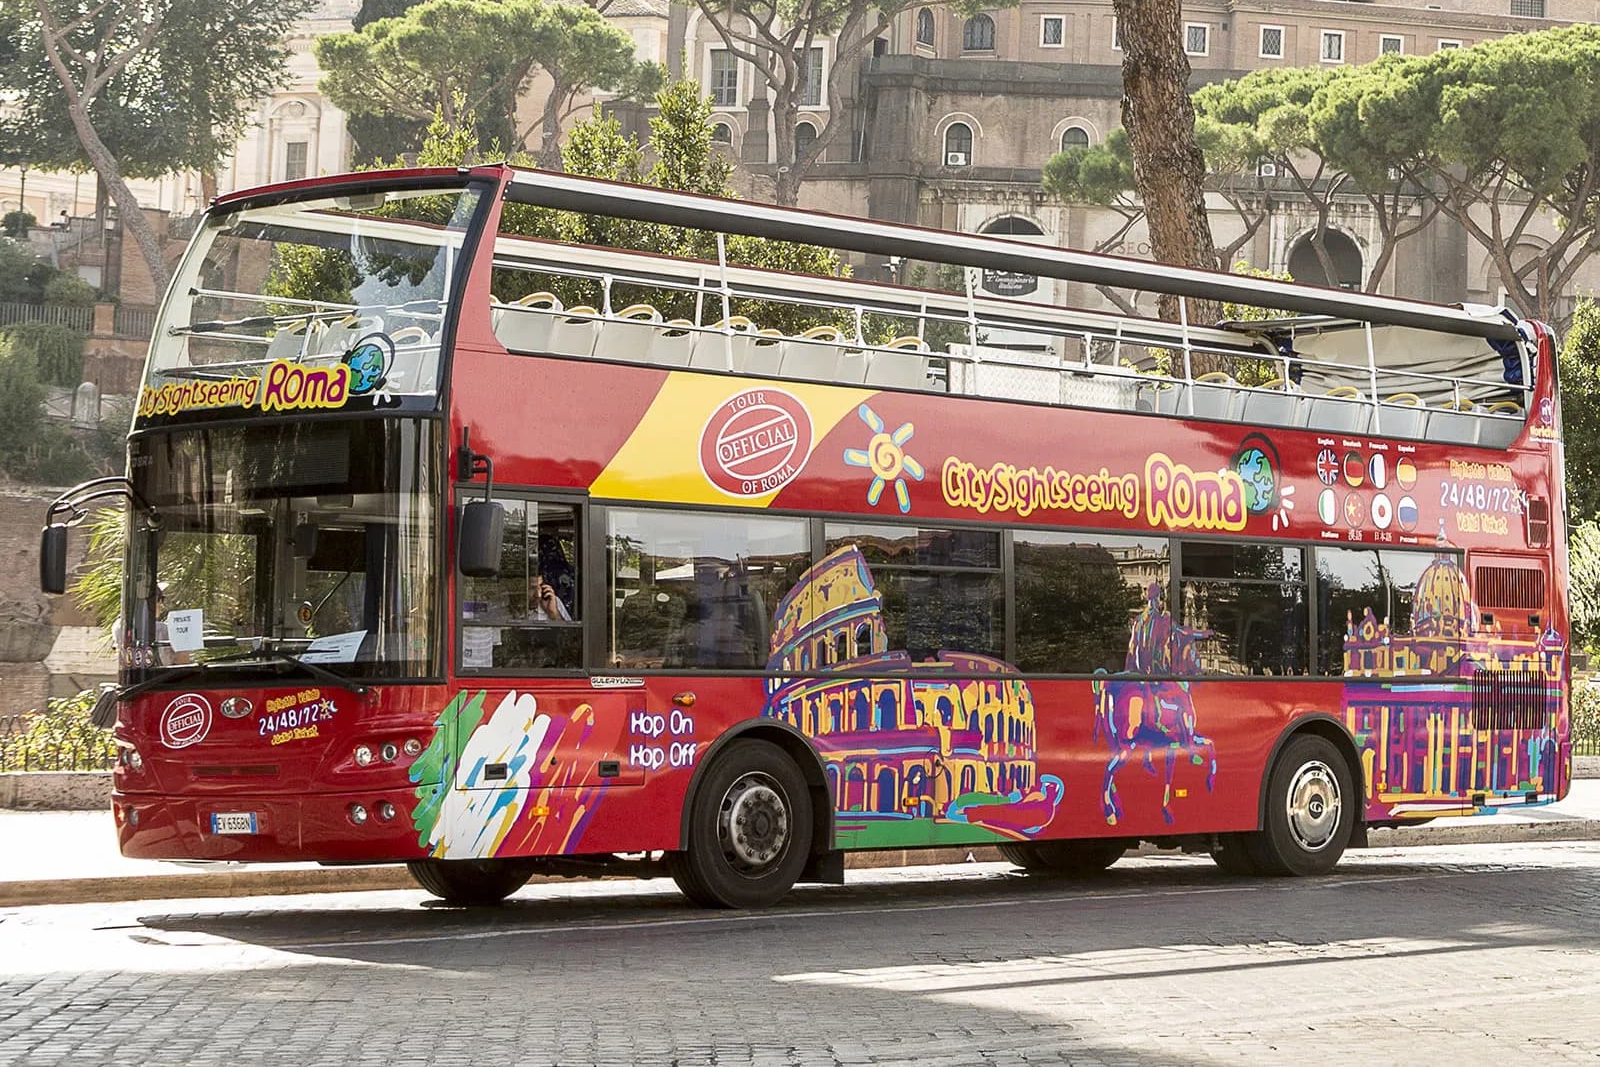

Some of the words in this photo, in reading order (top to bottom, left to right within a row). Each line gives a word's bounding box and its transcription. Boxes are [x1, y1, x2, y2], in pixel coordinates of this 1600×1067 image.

[263, 360, 348, 409] Roma
[728, 392, 766, 413] TOUR
[720, 423, 794, 462] OFFICIAL
[742, 480, 760, 493] OF
[761, 464, 795, 491] ROMA
[943, 459, 1138, 517] CitySightseeing
[1147, 455, 1244, 529] Roma
[1441, 482, 1510, 511] 24/48/72
[1456, 512, 1480, 532] Valid
[169, 713, 201, 732] OFFICIAL
[259, 704, 318, 736] 24/48/72
[631, 712, 665, 737] Hop
[670, 710, 693, 734] On
[630, 744, 664, 770] Hop
[670, 742, 696, 766] Off
